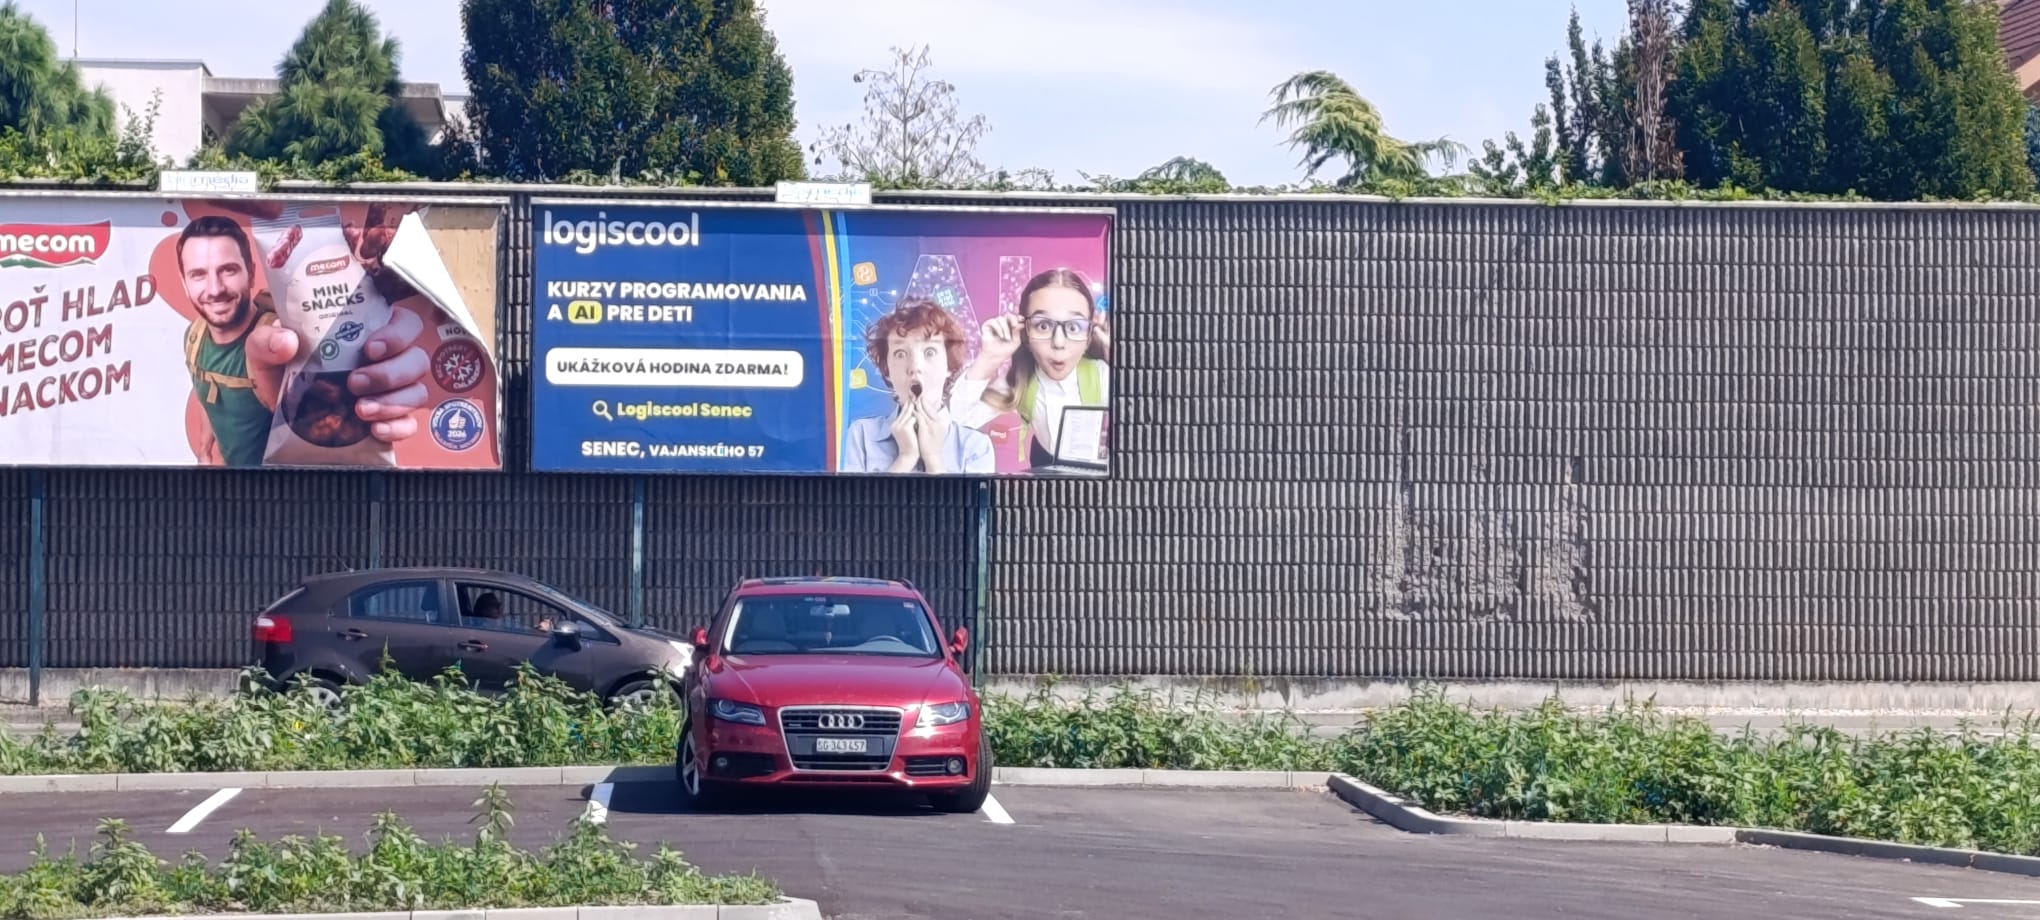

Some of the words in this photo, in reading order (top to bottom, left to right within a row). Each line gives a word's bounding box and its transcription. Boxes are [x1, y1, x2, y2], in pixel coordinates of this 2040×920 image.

[544, 210, 699, 254] logiscool
[0, 234, 95, 252] mecom
[310, 260, 347, 272] mecom
[313, 283, 349, 298] MINI
[547, 281, 616, 299] KURZY
[620, 283, 807, 301] PROGRAMOVANIA
[0, 284, 48, 335] OŤ
[61, 274, 157, 322] HLAD
[302, 292, 365, 312] SNACKS
[547, 304, 563, 320] A
[574, 305, 595, 320] AI
[607, 305, 646, 321] PRE
[648, 305, 693, 322] DETI
[0, 323, 113, 374] MECOM
[557, 358, 647, 374] UKÁŽKOVÁ
[650, 362, 712, 375] HODINA
[715, 363, 789, 376] ZDARMA!
[617, 401, 698, 420] Logiscool
[700, 403, 752, 418] Senec
[581, 441, 645, 459] SENEC,
[649, 443, 745, 458] VAJANSKÉHO
[748, 445, 765, 458] 57
[818, 741, 829, 751] SG
[830, 741, 847, 751] 343
[848, 741, 865, 752] 457
